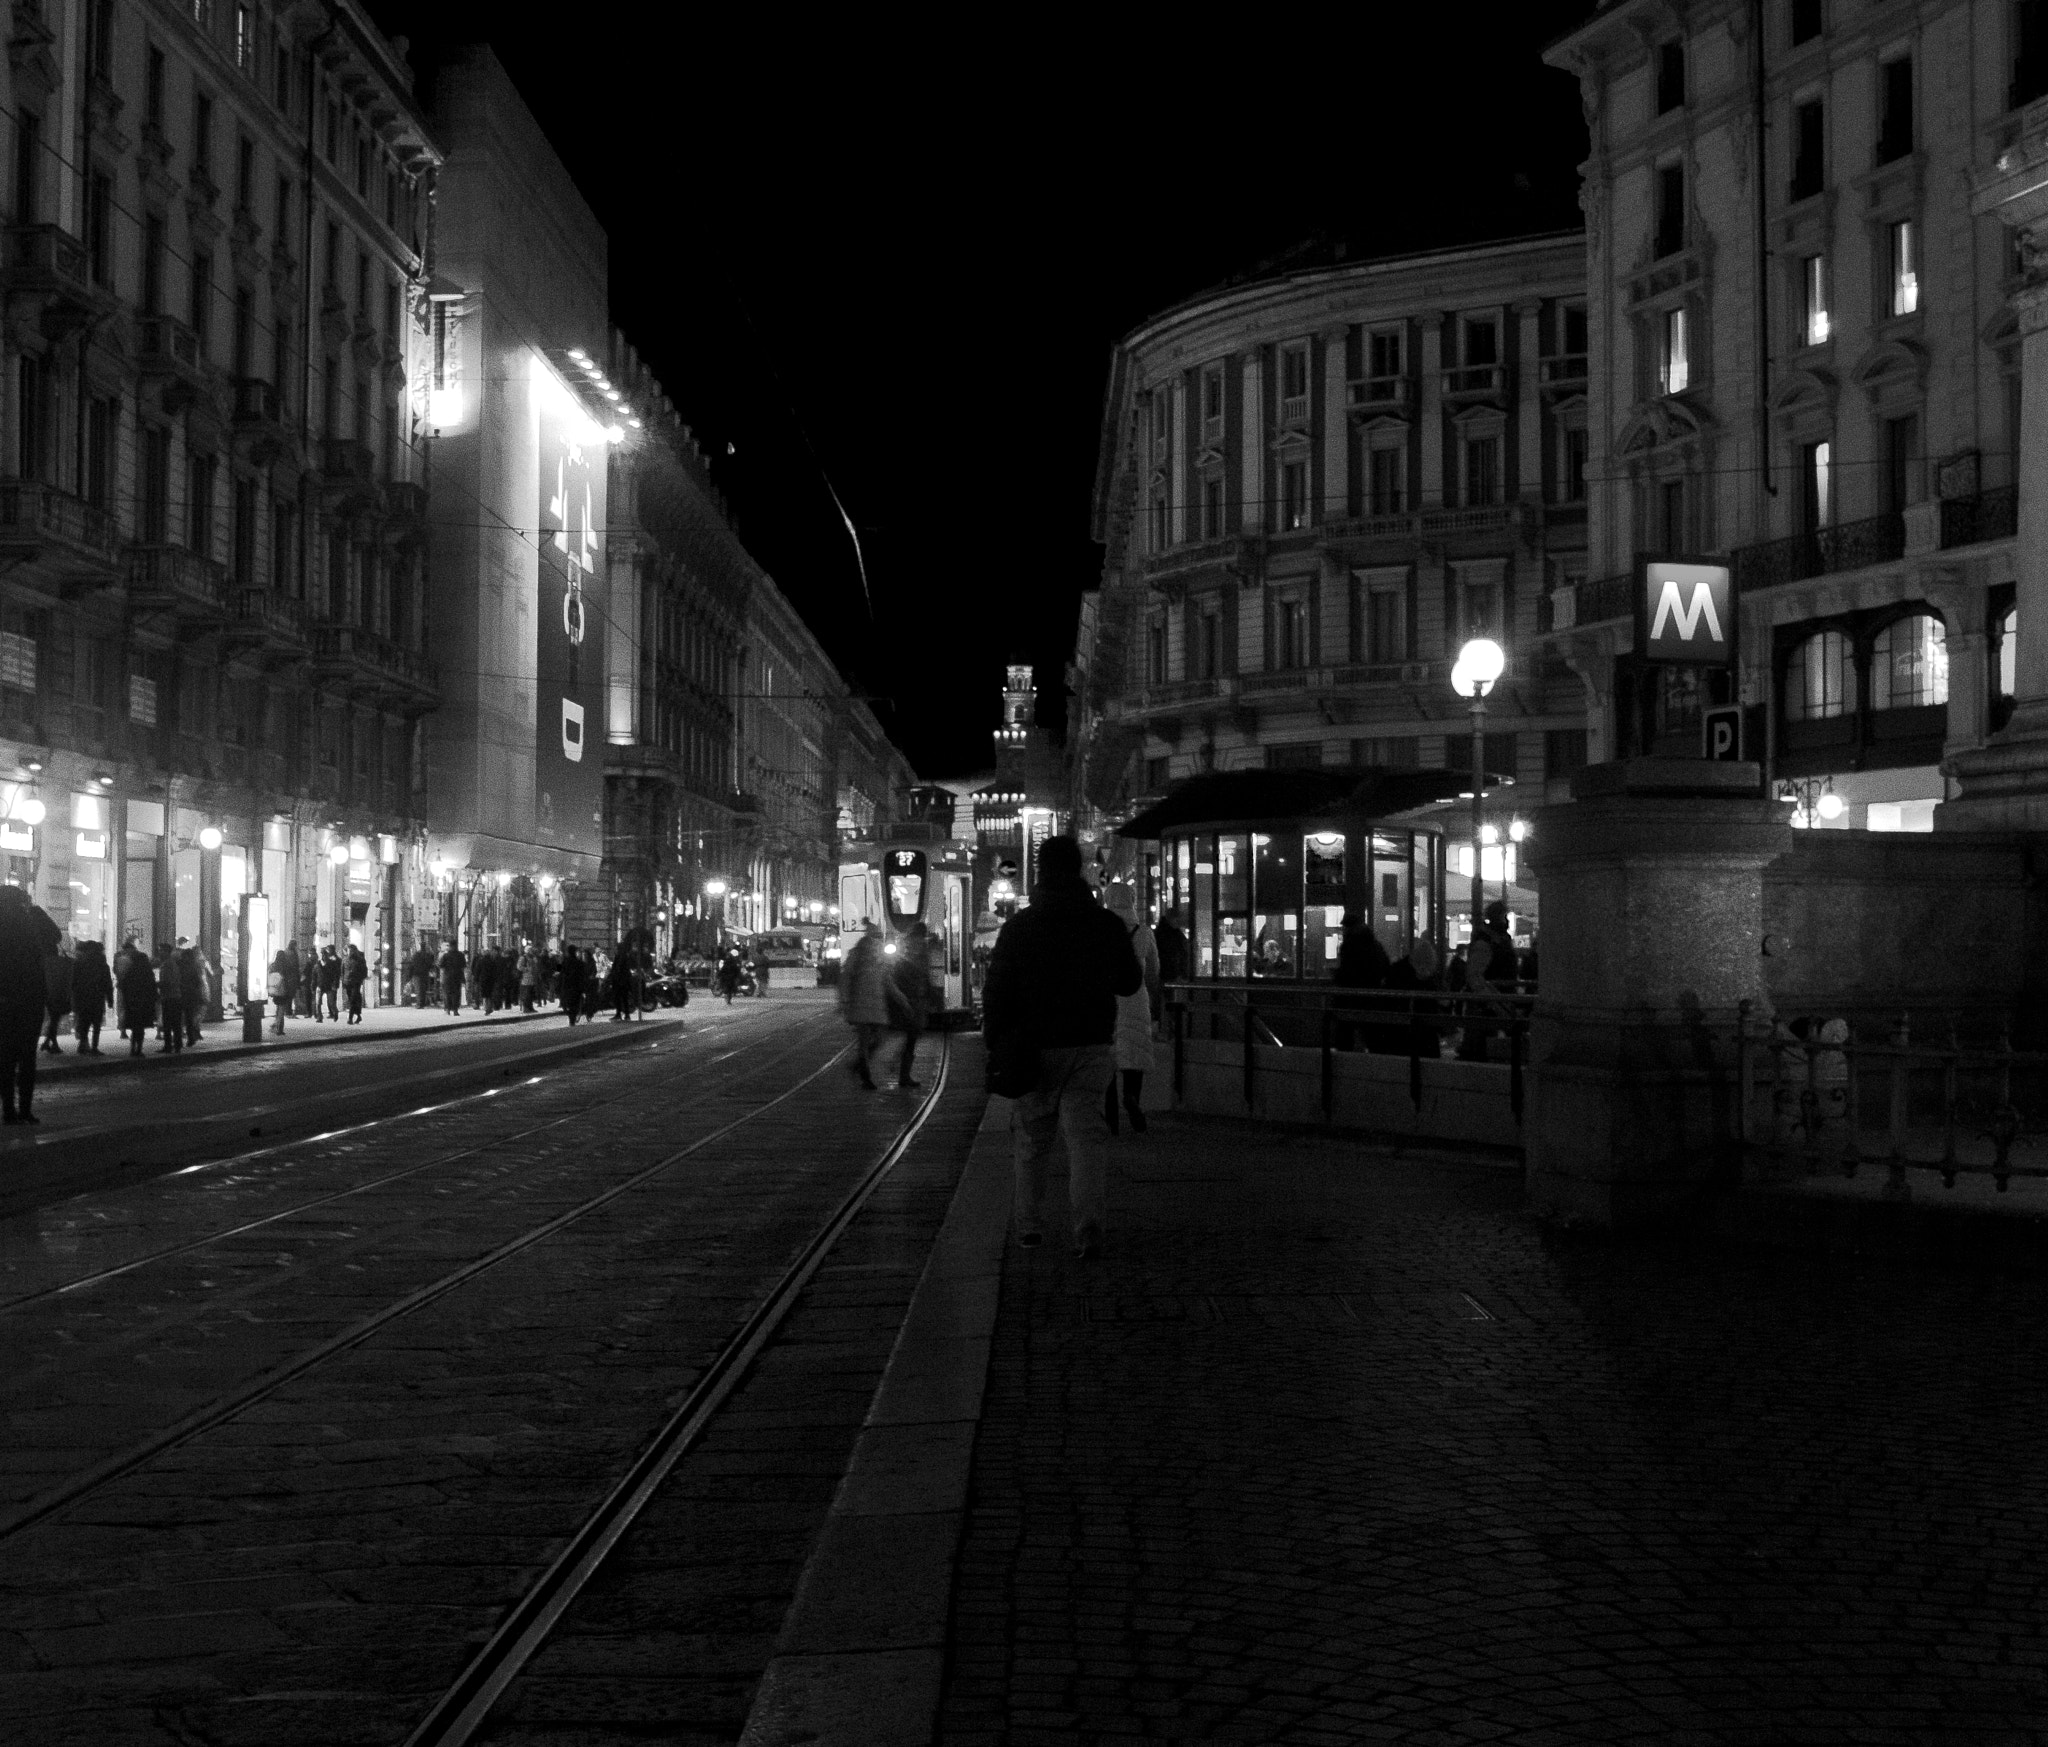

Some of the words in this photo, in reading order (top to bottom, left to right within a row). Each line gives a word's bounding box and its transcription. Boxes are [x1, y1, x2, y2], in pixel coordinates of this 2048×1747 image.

[1649, 581, 1724, 642] M
[1713, 721, 1733, 760] P
[898, 855, 914, 867] 27
